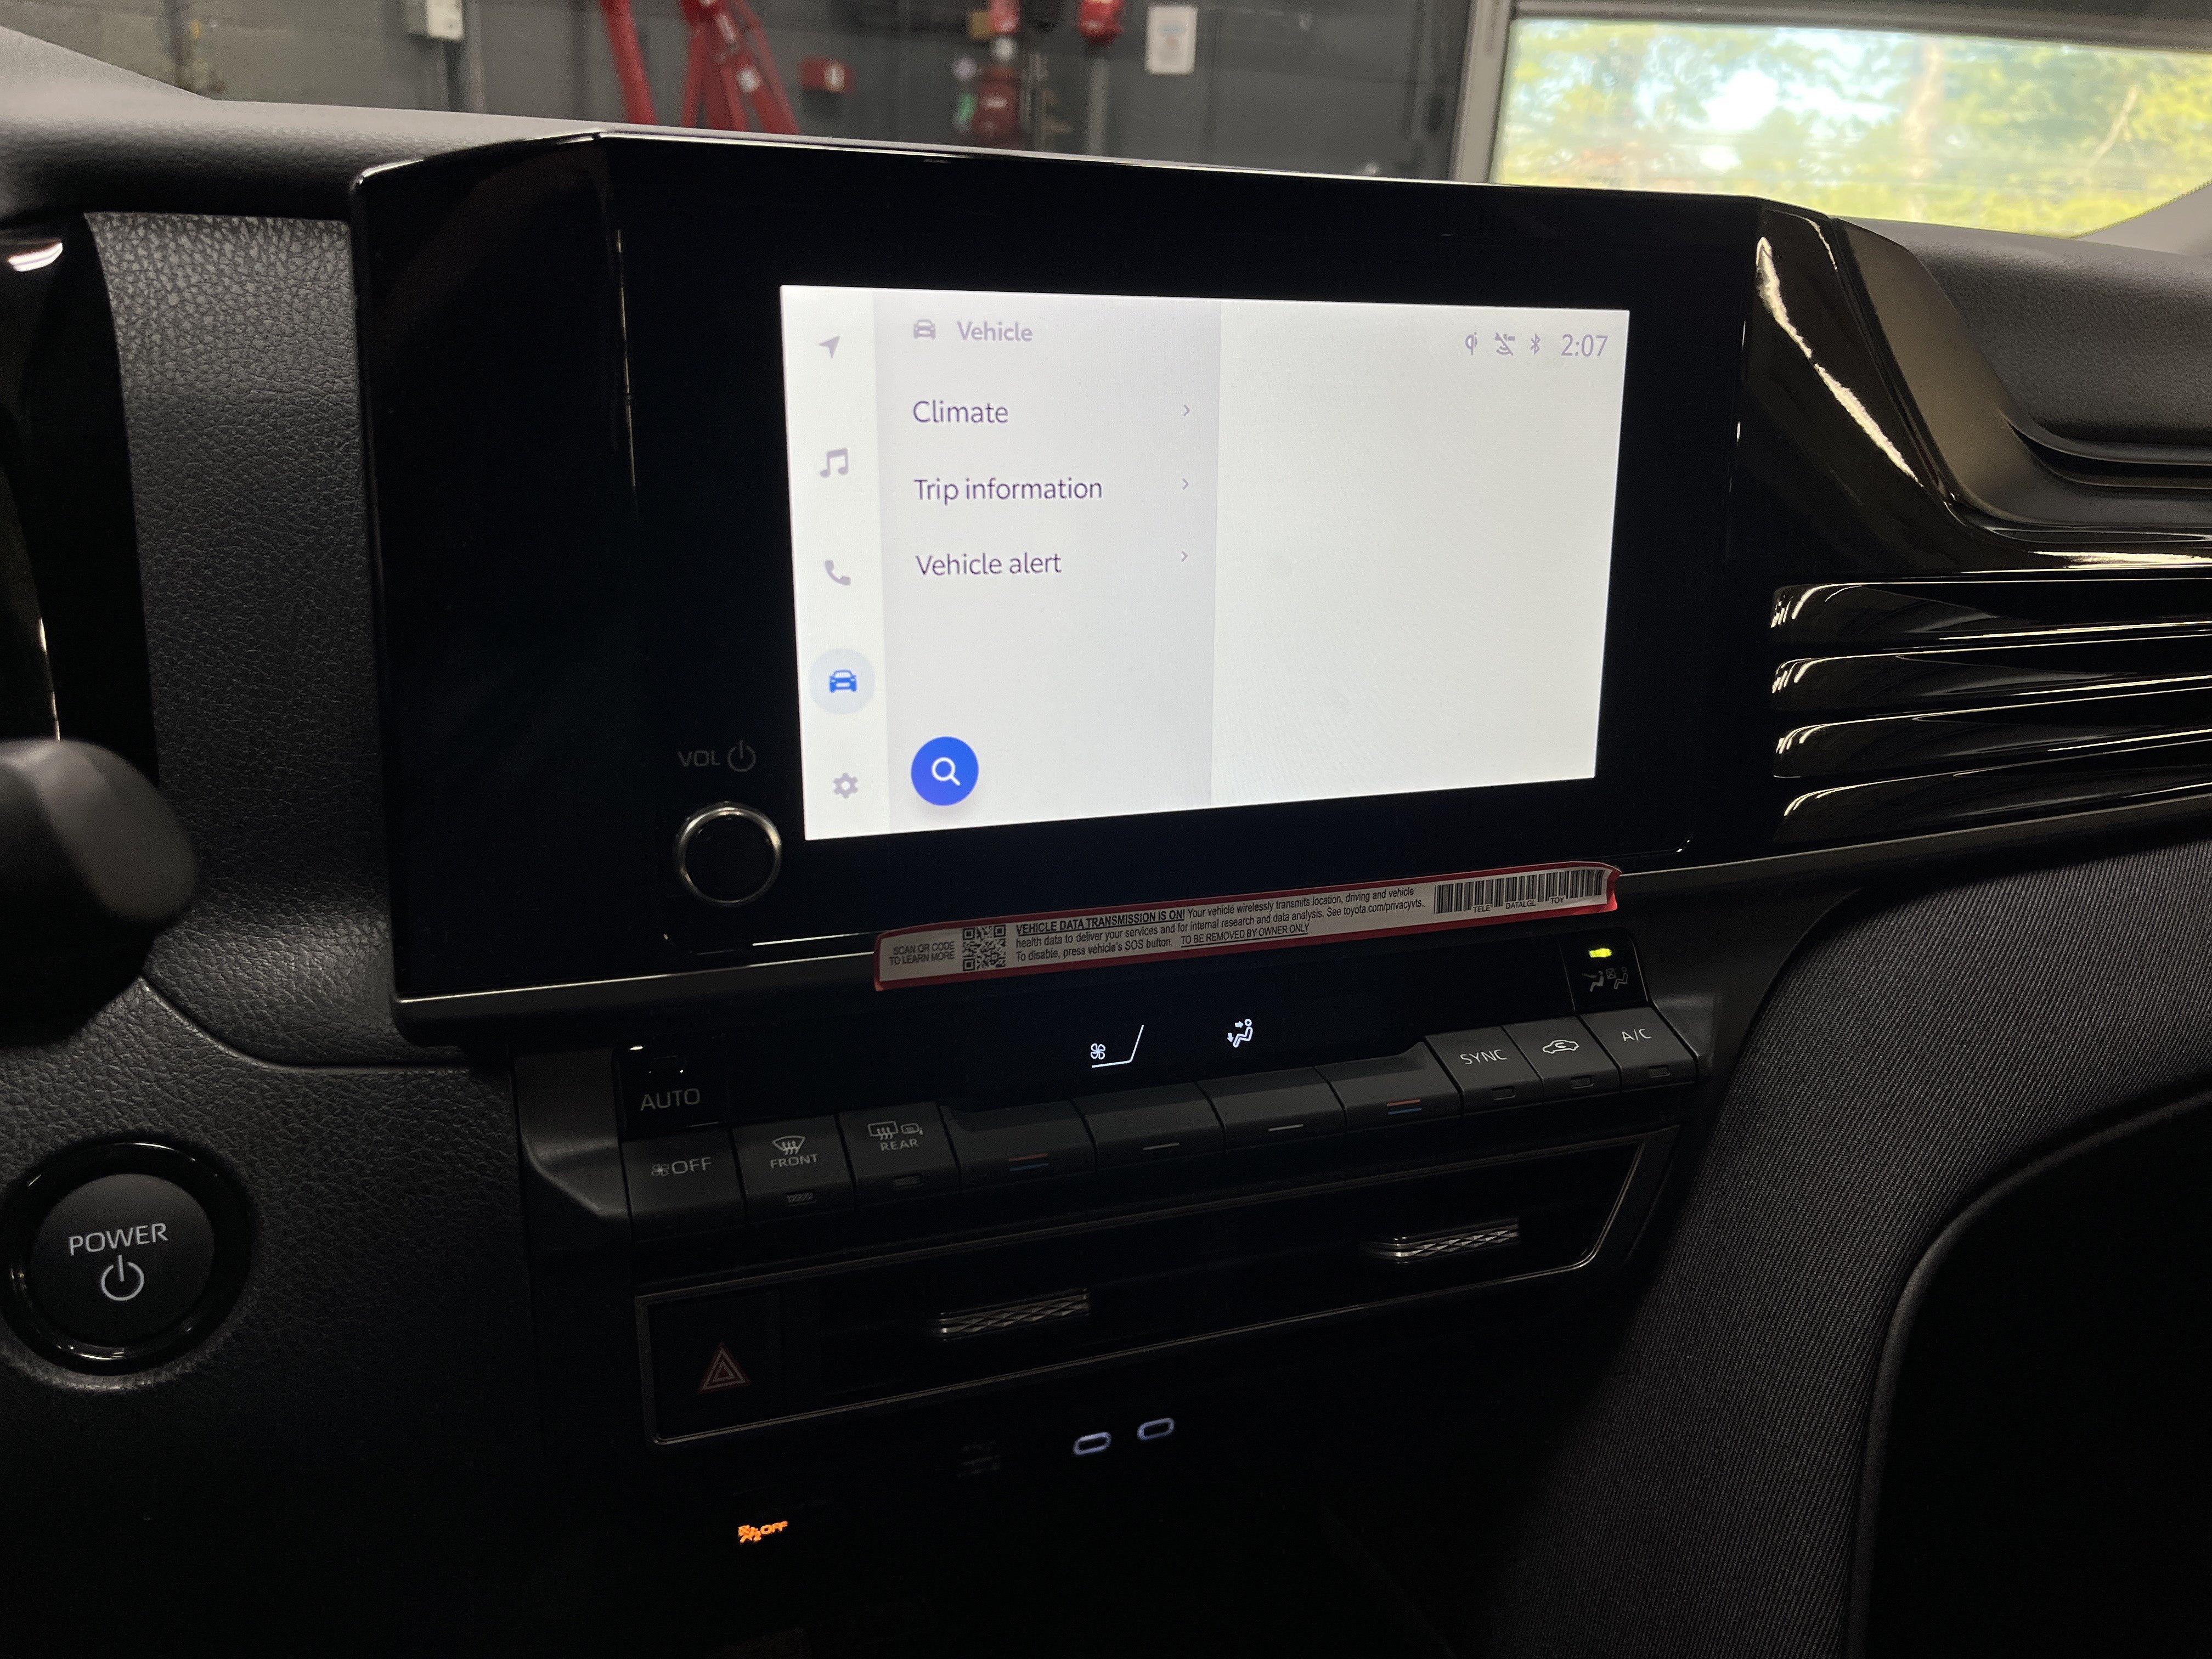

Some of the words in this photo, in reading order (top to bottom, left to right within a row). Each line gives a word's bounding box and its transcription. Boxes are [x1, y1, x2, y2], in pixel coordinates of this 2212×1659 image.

[957, 320, 1033, 342] Vehicle
[1560, 334, 1609, 357] 2:07
[912, 400, 1009, 424] Climate
[913, 479, 959, 505] Trip
[966, 477, 1103, 500] information
[915, 553, 1002, 576] Vehicle
[1009, 552, 1062, 574] alert
[677, 749, 721, 768] VOL
[1016, 921, 1057, 934] VEHICLE
[1060, 919, 1085, 930] DATA
[1086, 912, 1155, 927] TRANSMISSION
[1158, 911, 1166, 921] IS
[1188, 909, 1206, 918] Your
[1207, 905, 1234, 916] vehicle
[1237, 901, 1274, 913] wirelessly
[1276, 897, 1310, 909] transmits
[1312, 895, 1343, 906] location,
[1346, 892, 1370, 902] driving
[1373, 889, 1386, 899] and
[1389, 887, 1414, 898] vehicle
[1472, 905, 1491, 913] TELE
[1505, 900, 1536, 910] DATALGL
[1016, 936, 1041, 948] health
[1044, 934, 1062, 946] data
[1065, 934, 1073, 943] to
[1076, 930, 1103, 942] deliver
[1105, 929, 1123, 942] your
[1125, 927, 1158, 938] services
[1160, 924, 1175, 934] and
[1178, 922, 1188, 932] for
[1190, 919, 1219, 931] internal
[1221, 915, 1254, 928] research
[1256, 913, 1271, 924] and
[1273, 912, 1289, 922] data
[1291, 909, 1324, 922] analysis.
[1327, 907, 1341, 917] See
[1181, 935, 1192, 944] TO
[1194, 934, 1204, 944] BE
[1206, 929, 1245, 942] REMOVED
[1246, 928, 1257, 938] BY
[1259, 925, 1288, 937] OWNER
[1289, 923, 1310, 933] ONLY
[889, 956, 900, 966] TO
[902, 953, 929, 964] LEARN
[932, 951, 955, 961] MORE
[894, 946, 916, 955] SCAN
[933, 941, 955, 951] CODE
[1017, 951, 1026, 962] To
[1028, 948, 1060, 960] disable,
[1063, 946, 1086, 958] press
[1087, 941, 1122, 955] vehicle's
[1125, 939, 1143, 951] SOS
[1146, 938, 1173, 949] button.
[1621, 1028, 1651, 1042] A/C
[1459, 1048, 1506, 1065] SYNC
[639, 1087, 701, 1111] AUTO
[880, 1138, 919, 1152] REAR
[672, 1156, 712, 1175] OFF
[770, 1153, 819, 1169] FRONT
[68, 1222, 168, 1255] POWER
